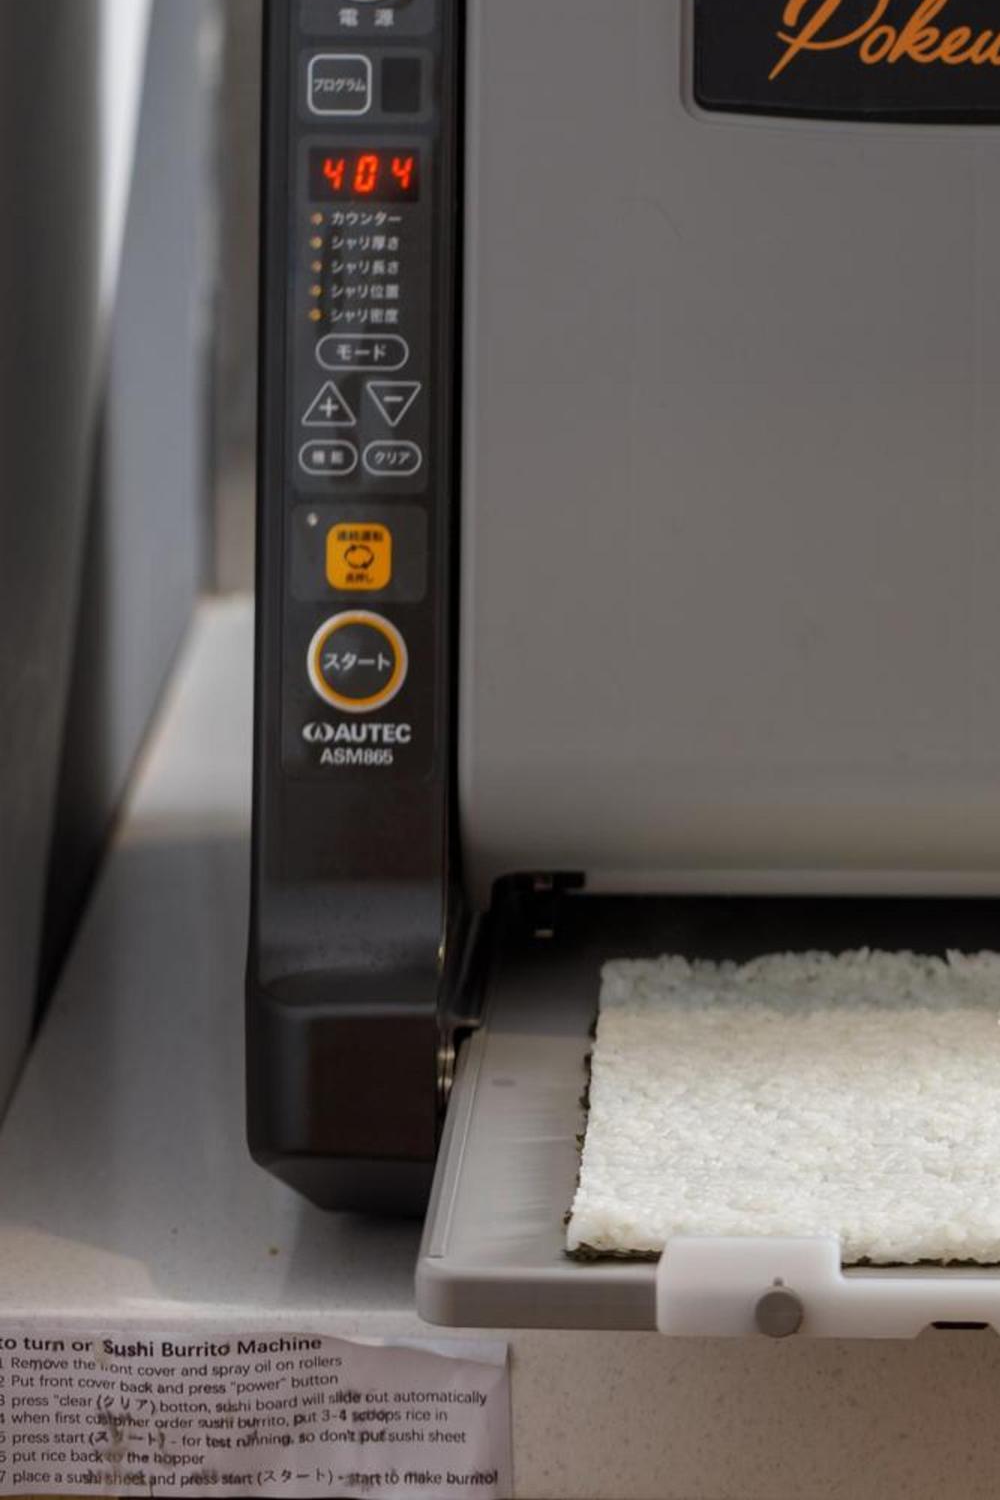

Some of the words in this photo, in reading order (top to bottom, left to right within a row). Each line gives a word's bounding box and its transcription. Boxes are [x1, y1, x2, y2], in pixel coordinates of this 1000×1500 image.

[323, 153, 414, 193] 404
[331, 210, 402, 226] カウンター
[336, 343, 387, 361] モード
[374, 452, 410, 465] クリア
[323, 652, 391, 672] スタート
[334, 723, 411, 743] AUTEC
[24, 1337, 65, 1352] turn
[103, 1339, 154, 1358] Sushi
[161, 1341, 230, 1357] Burrito
[237, 1337, 322, 1355] Machine
[11, 1357, 69, 1371] Remove
[73, 1359, 96, 1370] the
[137, 1365, 175, 1376] cover
[181, 1364, 207, 1376] and
[212, 1362, 250, 1378] spray
[255, 1359, 271, 1373] oil
[275, 1360, 294, 1371] on
[299, 1356, 342, 1369] rollers
[11, 1375, 34, 1387] Put
[40, 1374, 73, 1388] front
[77, 1379, 115, 1390] cover
[120, 1381, 153, 1394] back
[157, 1382, 184, 1394] and
[188, 1384, 226, 1397] press
[291, 1375, 338, 1388] button
[11, 1396, 49, 1409] press
[215, 1400, 251, 1413] sushi
[255, 1396, 298, 1411] board
[302, 1393, 324, 1406] will
[394, 1388, 487, 1407] automatically
[11, 1411, 50, 1424] when
[55, 1411, 81, 1424] first
[154, 1417, 193, 1429] order
[293, 1411, 317, 1427] put
[405, 1408, 431, 1421] rice
[435, 1408, 448, 1422] in
[12, 1432, 50, 1446] press
[53, 1431, 85, 1444] start
[182, 1434, 201, 1447] for
[206, 1434, 232, 1448] test
[299, 1432, 315, 1443] so
[360, 1430, 386, 1444] put
[388, 1428, 424, 1443] sushi
[428, 1429, 466, 1443] sheet
[12, 1451, 35, 1465] put
[41, 1451, 67, 1462] rice
[70, 1449, 103, 1463] back
[127, 1451, 149, 1464] the
[154, 1452, 205, 1467] hopper
[12, 1470, 51, 1485] place
[54, 1473, 63, 1483] a
[221, 1473, 253, 1485] start
[385, 1469, 400, 1484] to
[404, 1470, 442, 1485] make
